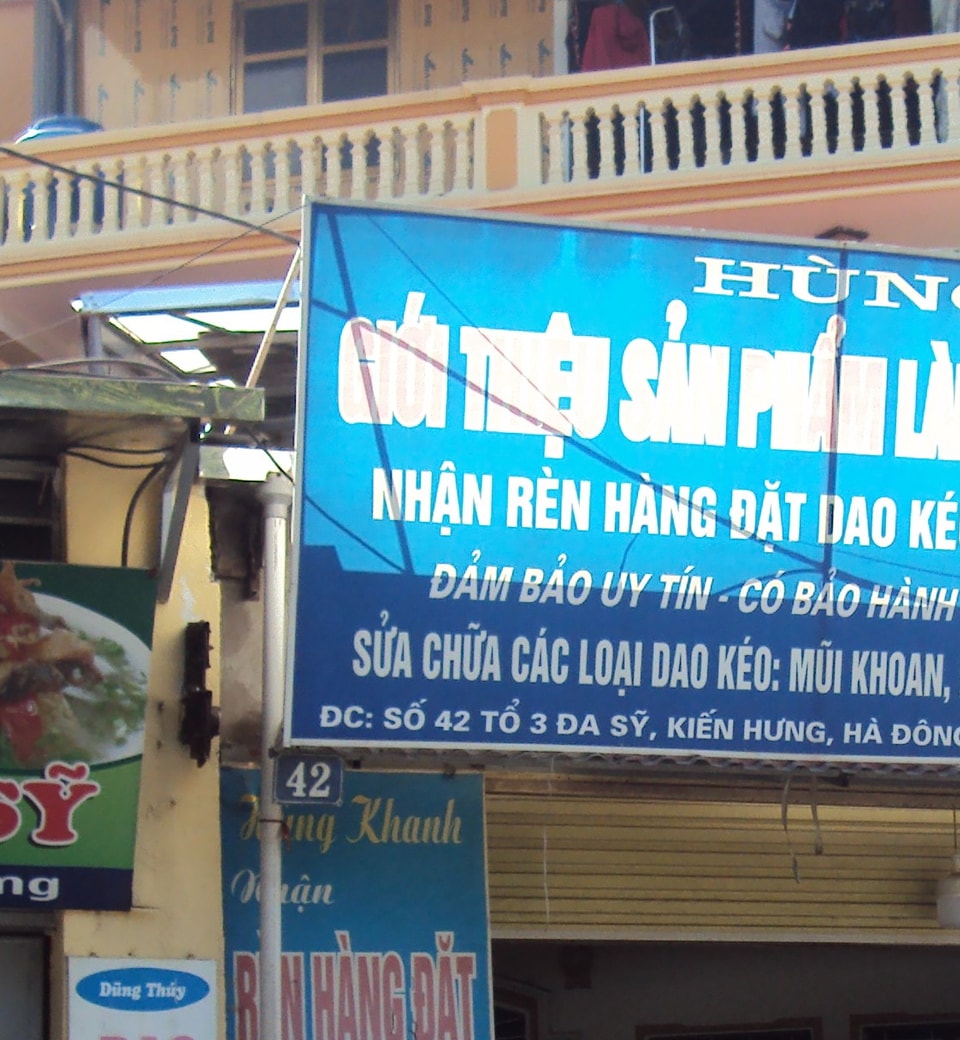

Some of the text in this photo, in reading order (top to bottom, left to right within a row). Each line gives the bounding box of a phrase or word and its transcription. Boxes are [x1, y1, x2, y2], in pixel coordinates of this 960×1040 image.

[338, 292, 450, 428] GIỚI
[459, 311, 611, 460] THIỆU
[619, 299, 732, 447] SẢN
[372, 461, 494, 538] NHẬN
[506, 462, 590, 532] RÈN
[604, 473, 717, 537] HÀNG
[729, 479, 807, 554] ĐẶT
[817, 494, 896, 548] DAO
[429, 549, 516, 601] ĐẢM
[518, 552, 593, 606] BẢO
[600, 571, 652, 608] UY
[657, 565, 713, 612] TÍN
[718, 595, 729, 603] -
[737, 571, 786, 615] CÓ
[791, 568, 861, 618] BẢO
[866, 575, 960, 623] HÀNH
[352, 609, 412, 679] SỬA
[422, 621, 502, 682] CHỮA
[510, 627, 571, 685] CÁC
[578, 638, 644, 697] LOẠI
[651, 641, 708, 689] DAO
[716, 636, 780, 692] KÉO:
[788, 640, 842, 695] MŨI
[850, 651, 952, 704] KHOAN,
[319, 704, 374, 729] ĐC:
[382, 698, 426, 731] SỐ
[434, 710, 470, 732] 42
[480, 698, 521, 734] TỔ
[529, 712, 548, 735] 3
[556, 712, 601, 737] ĐA
[609, 709, 657, 743] SỸ,
[667, 708, 735, 741] KIẾN
[743, 716, 834, 748] HƯNG,
[843, 719, 881, 745] HÀ
[285, 762, 332, 798] 42
[345, 795, 463, 845] Khanh
[231, 868, 335, 913] Nận
[99, 981, 142, 1001] Dũng
